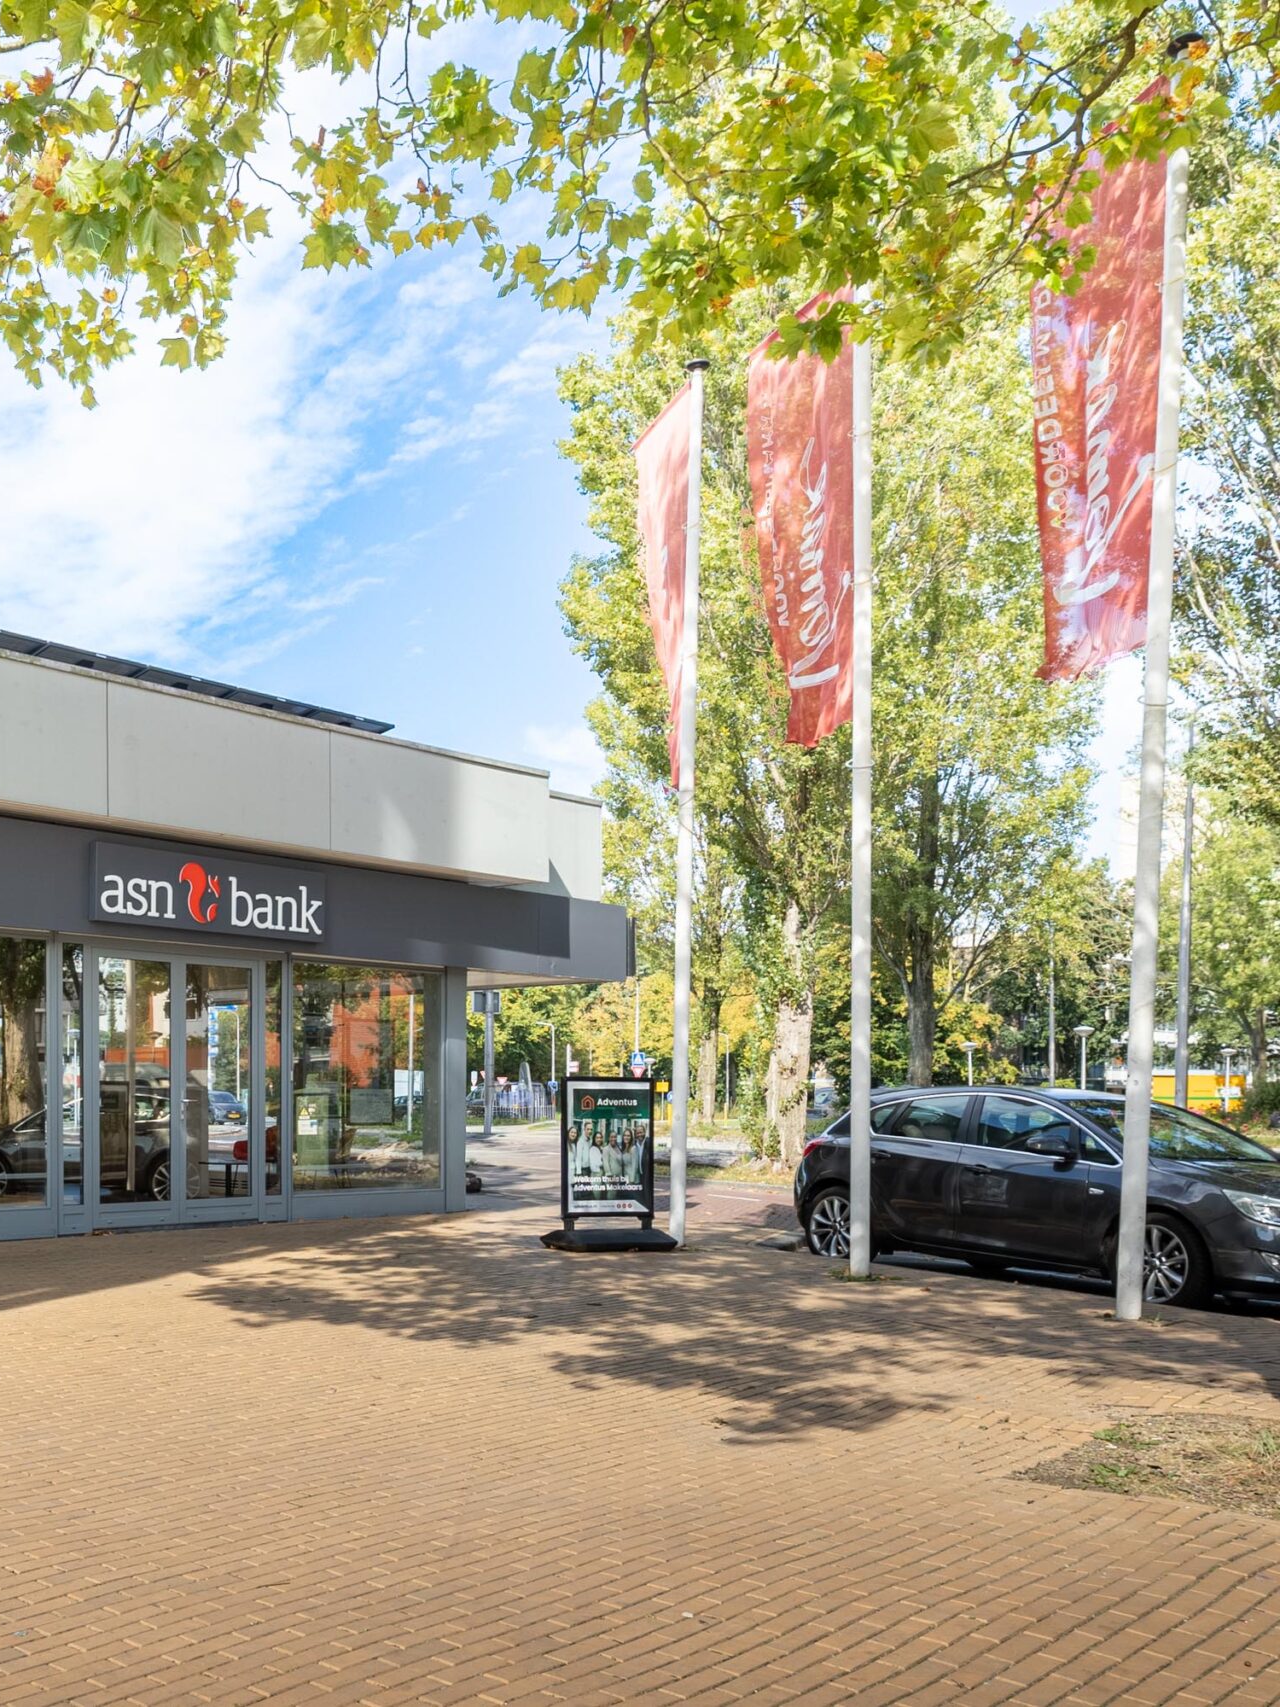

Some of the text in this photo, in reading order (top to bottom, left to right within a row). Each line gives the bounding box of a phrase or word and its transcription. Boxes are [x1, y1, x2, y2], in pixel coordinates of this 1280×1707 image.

[100, 873, 323, 936] asn bank
[597, 1098, 638, 1106] Adventus
